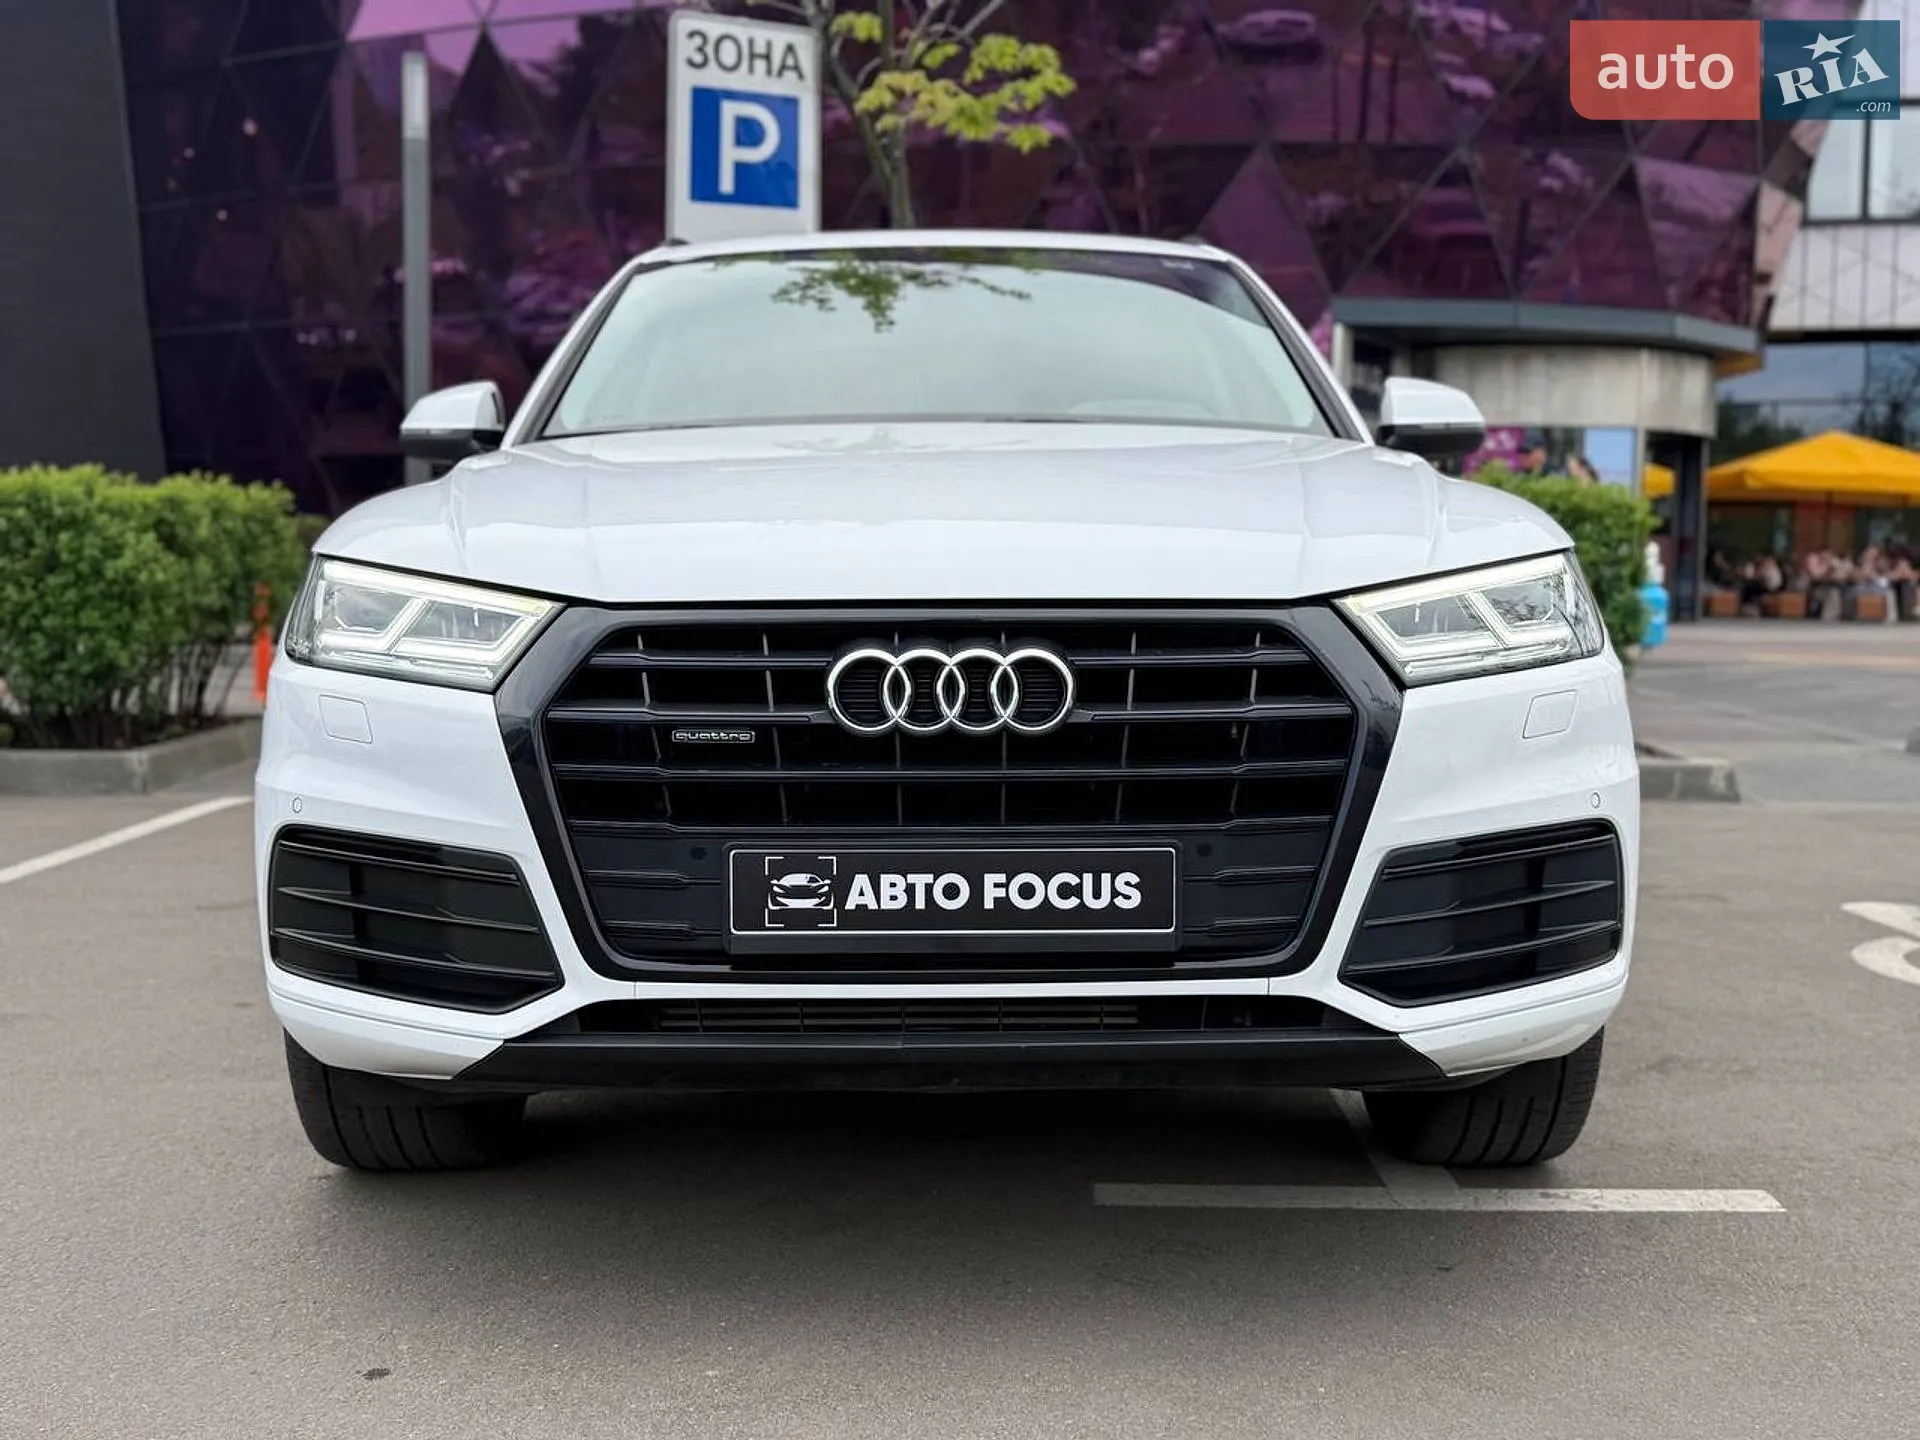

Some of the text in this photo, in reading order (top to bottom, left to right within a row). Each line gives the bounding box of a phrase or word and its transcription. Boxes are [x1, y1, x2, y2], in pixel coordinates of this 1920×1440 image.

[685, 29, 805, 80] ЗОНА
[719, 99, 780, 195] P
[675, 732, 751, 742] quattro
[844, 872, 1142, 911] АВТО FOCUS
